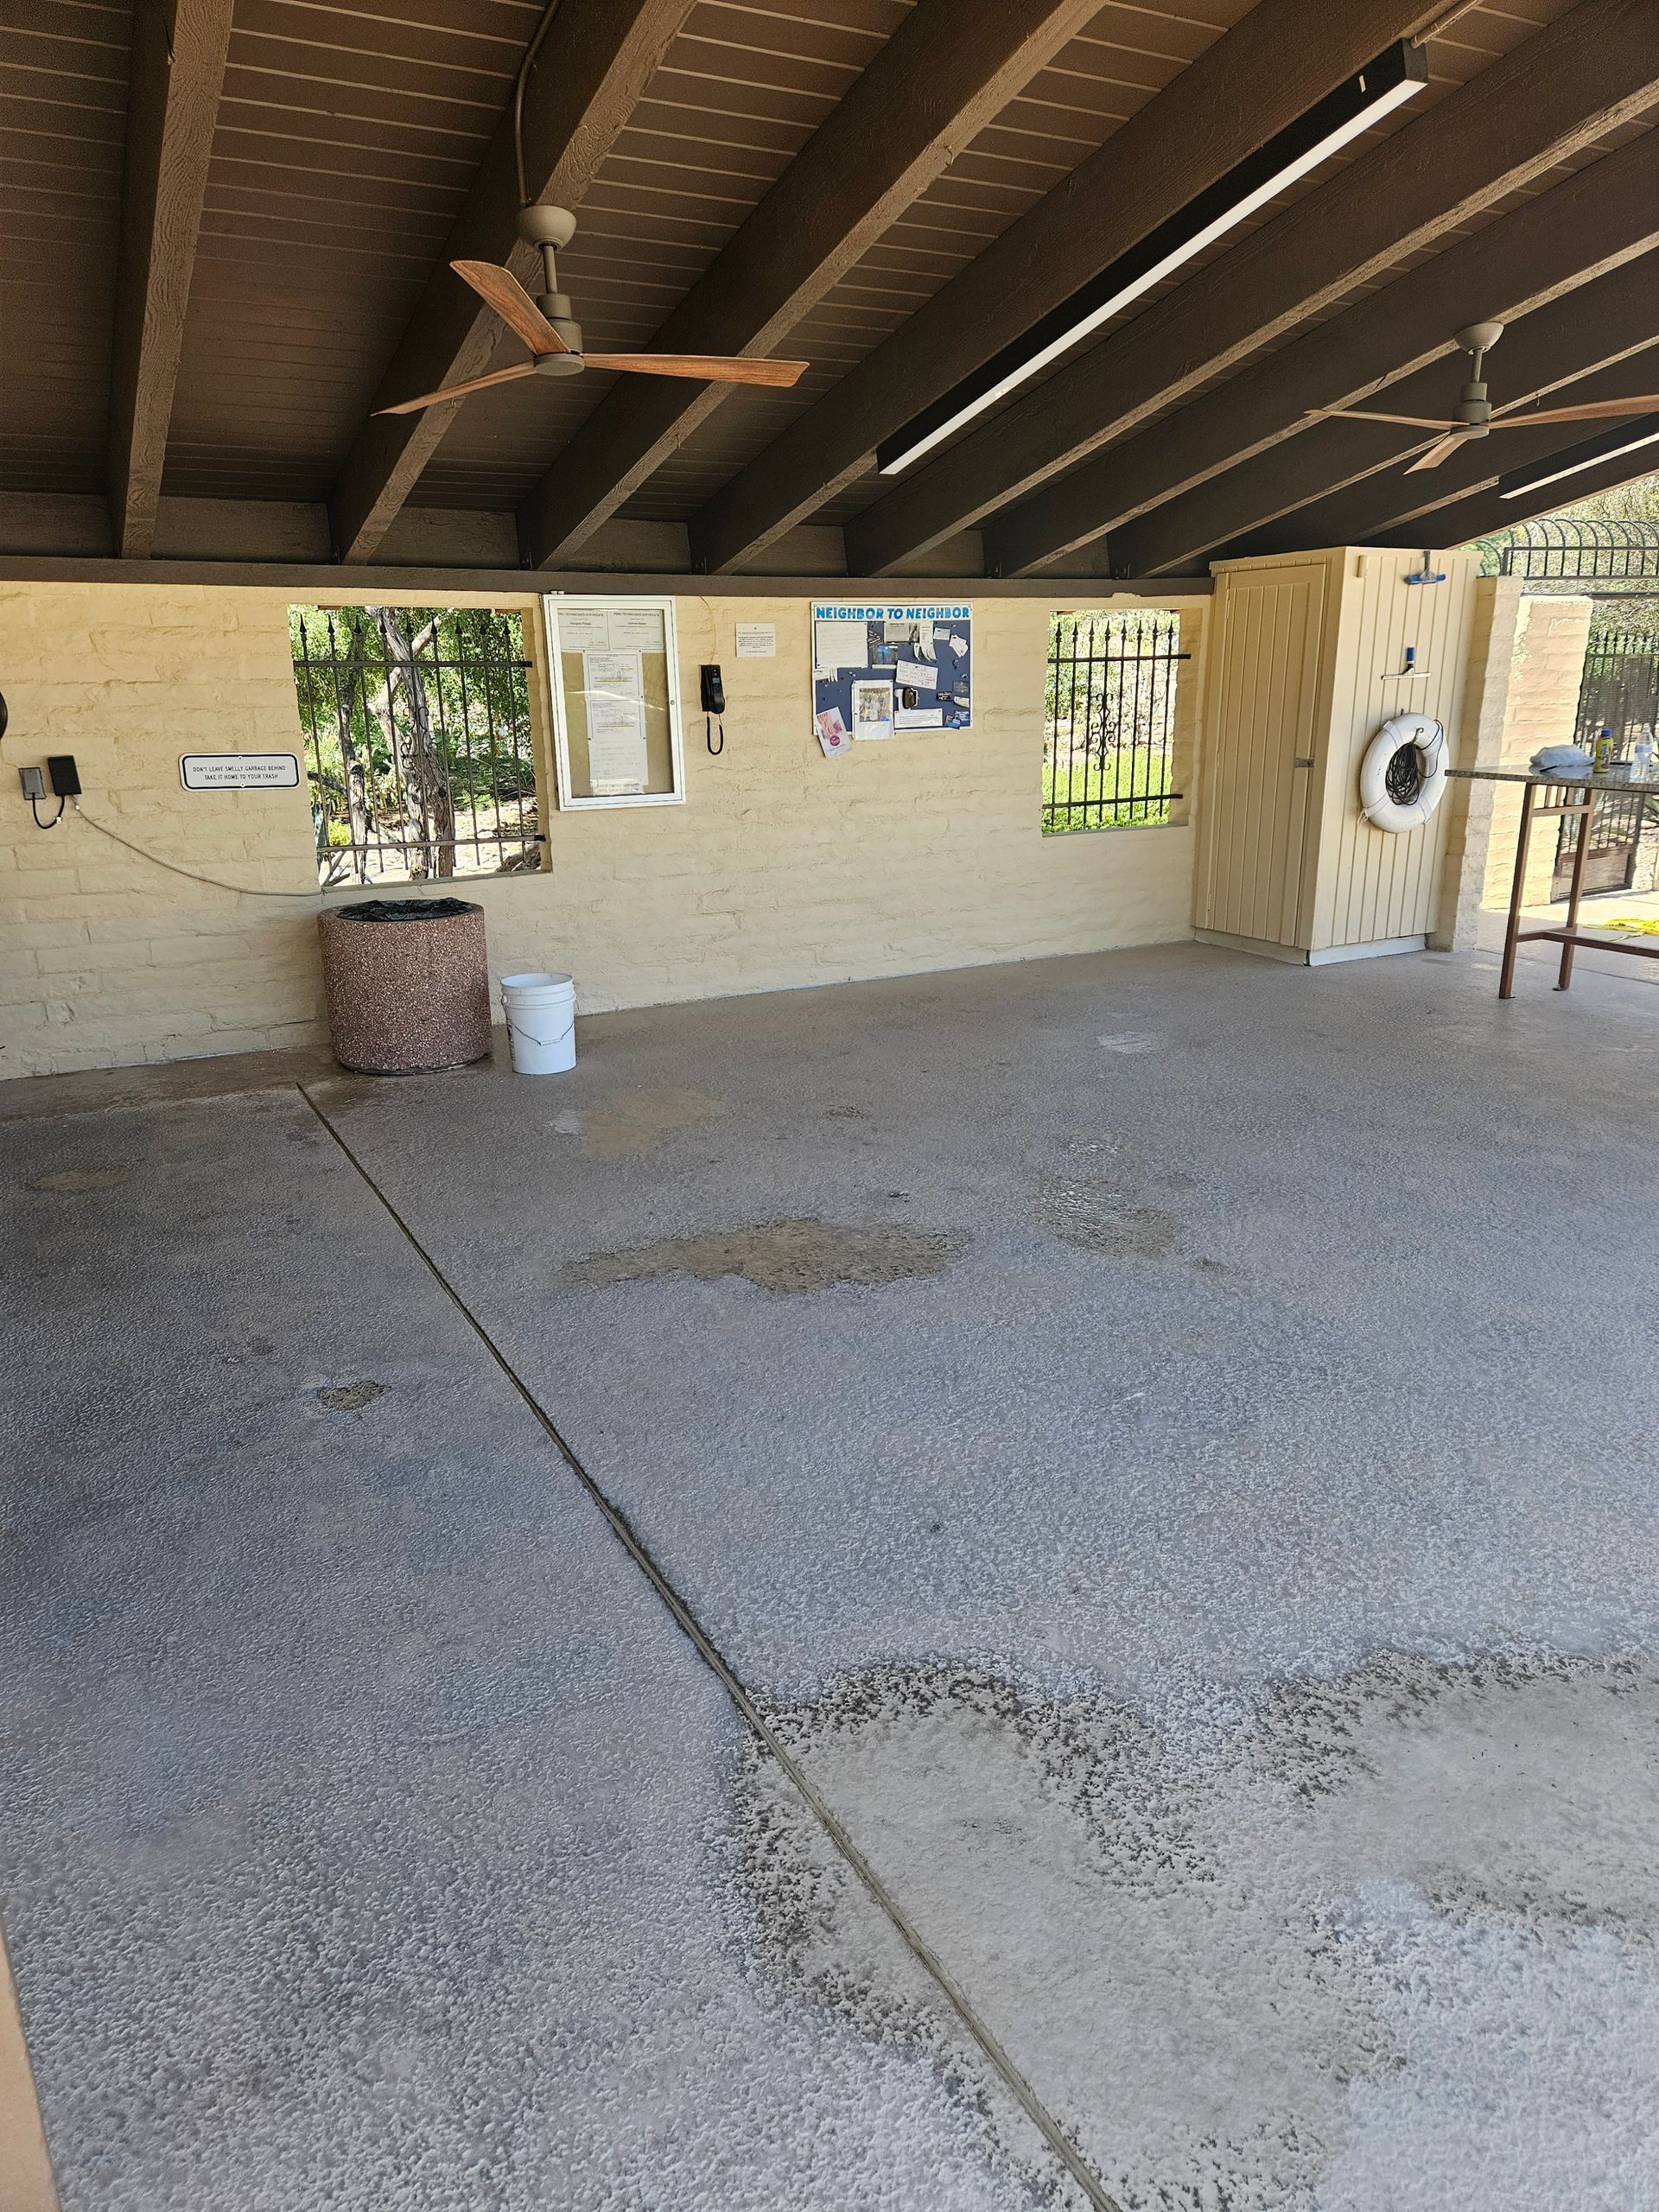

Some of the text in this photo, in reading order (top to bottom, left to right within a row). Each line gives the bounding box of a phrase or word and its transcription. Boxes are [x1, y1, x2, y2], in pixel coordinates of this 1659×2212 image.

[816, 607, 969, 620] NEIGHBOR TO NEIGHBOR
